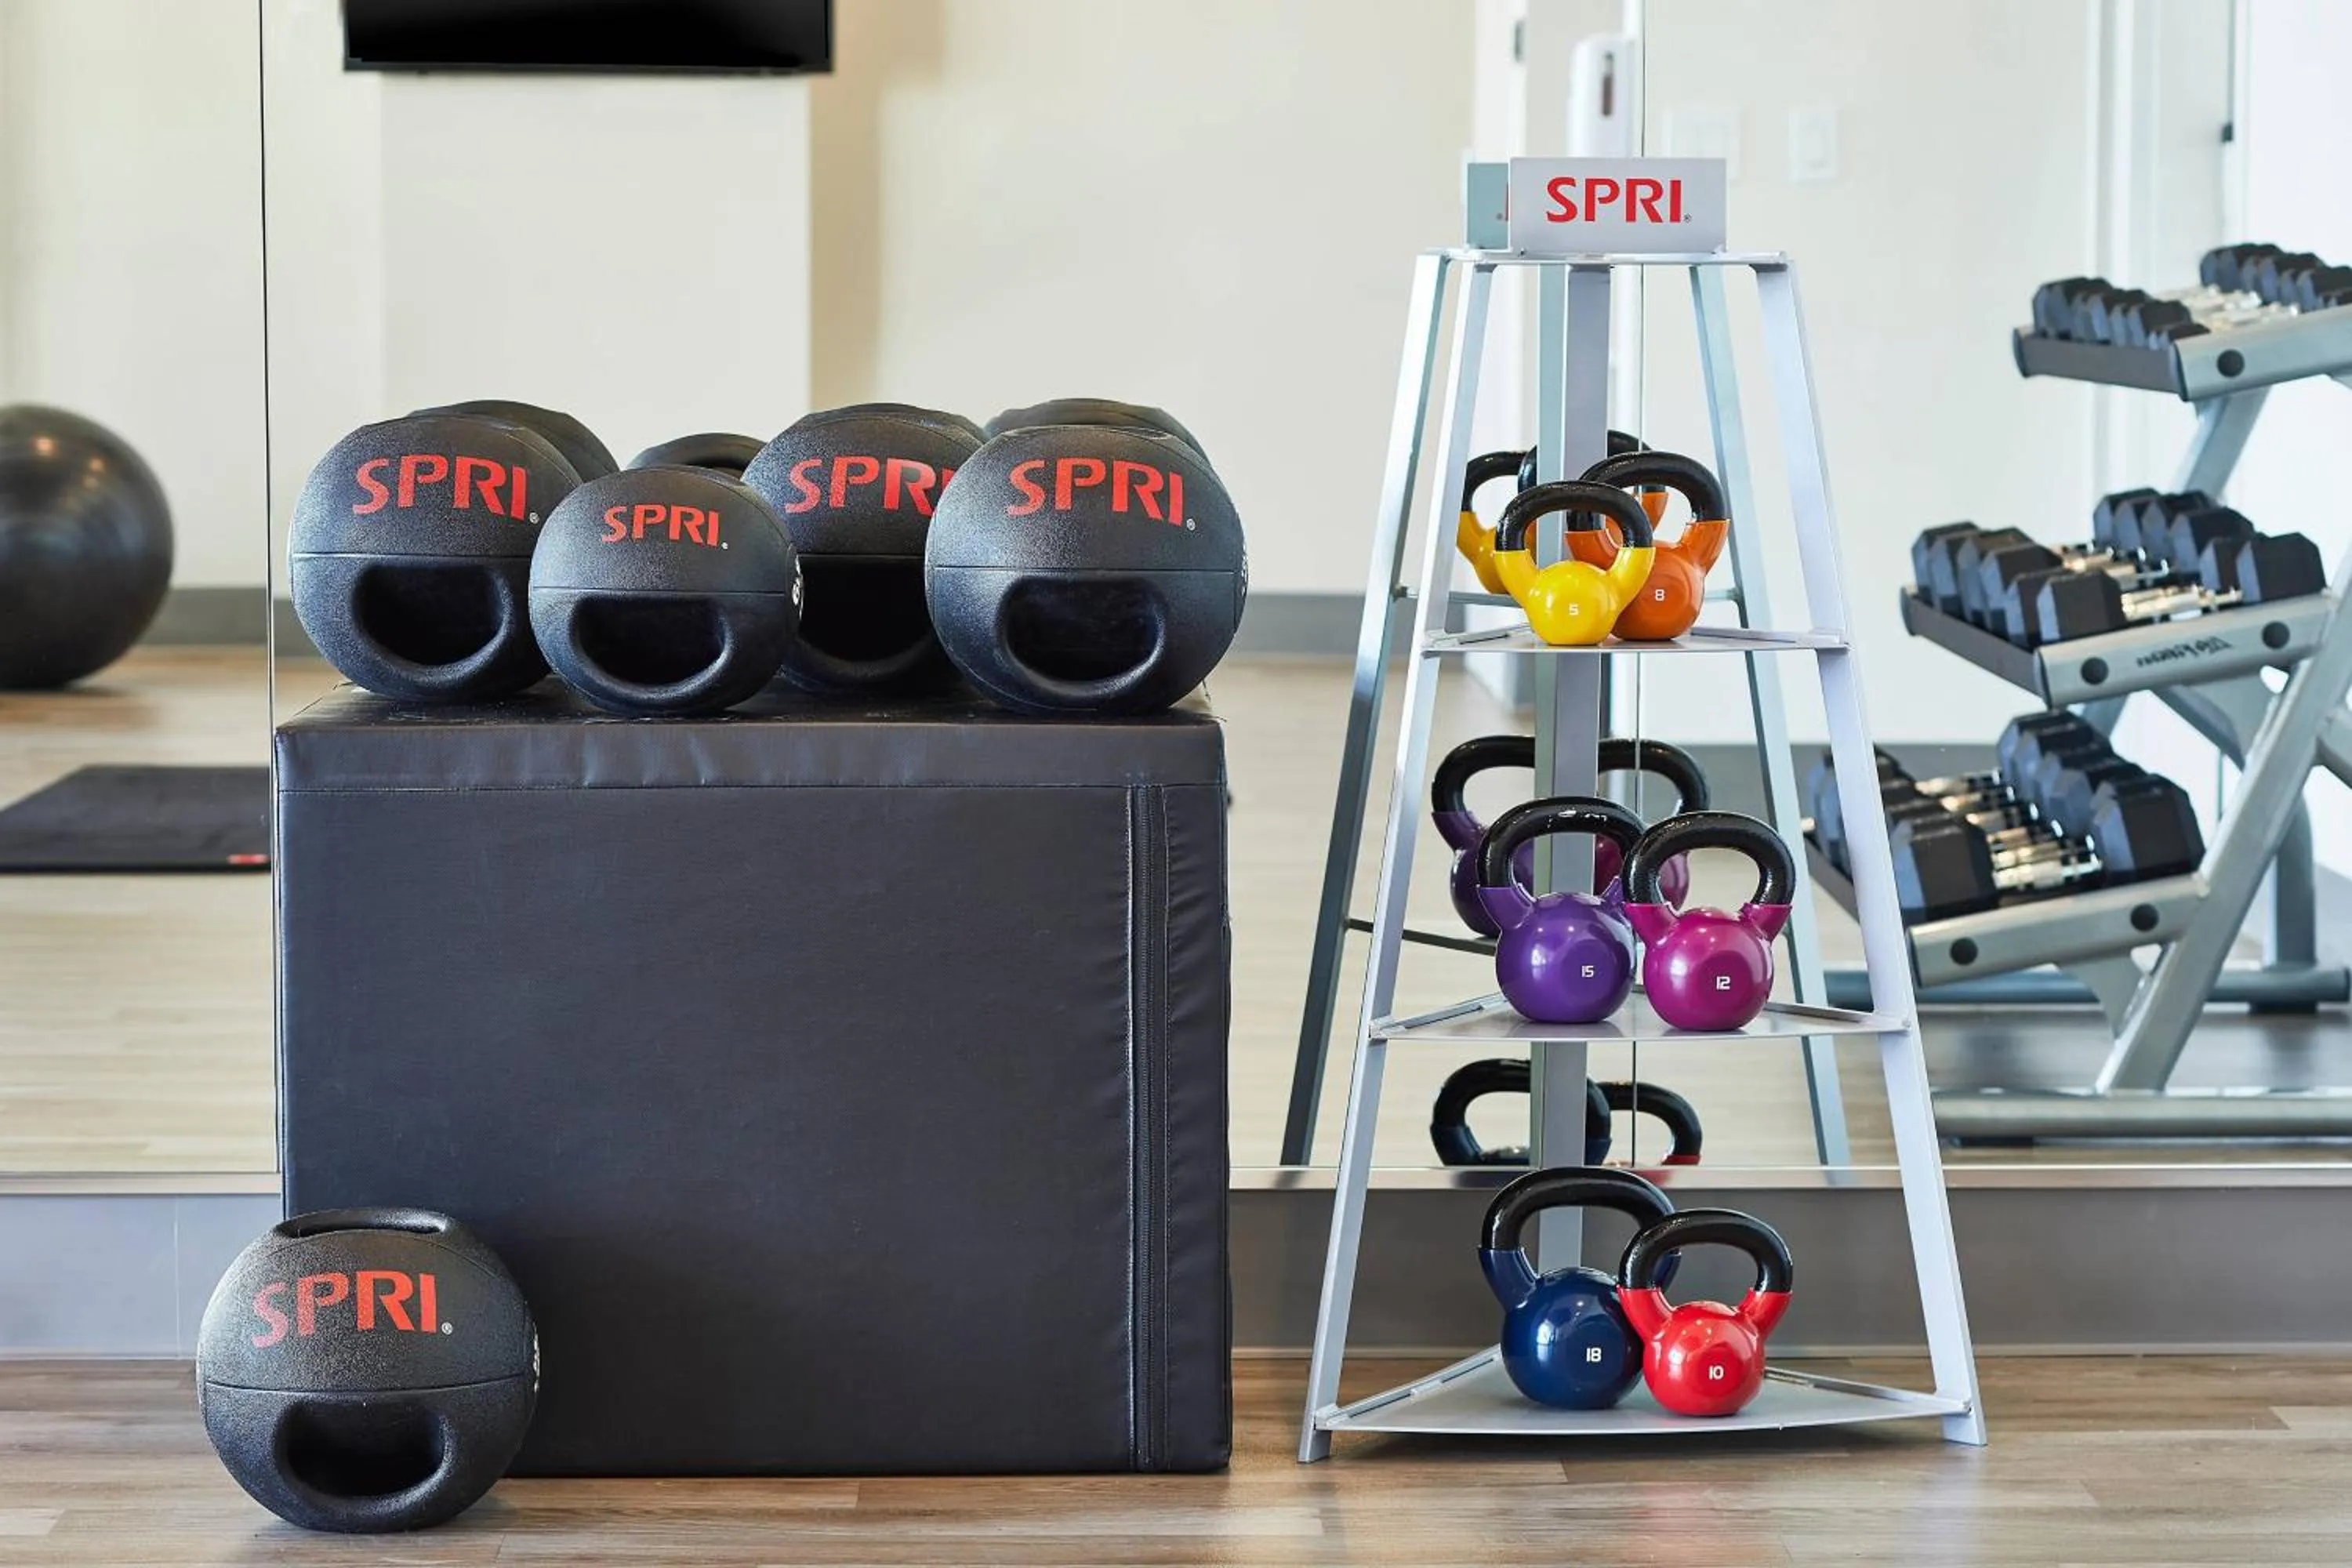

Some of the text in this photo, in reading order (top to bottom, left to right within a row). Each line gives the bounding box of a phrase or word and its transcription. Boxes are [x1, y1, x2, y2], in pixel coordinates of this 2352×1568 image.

[1546, 176, 1682, 223] SPRI
[352, 453, 528, 521] SPRI
[1007, 456, 1184, 527] SPRI
[601, 503, 720, 547] SPRI
[1655, 589, 1665, 601] 8
[1569, 603, 1580, 615] 5
[1581, 965, 1594, 978] 15
[1716, 976, 1731, 990] 12
[252, 1269, 437, 1348] SPRI
[1586, 1347, 1602, 1363] 18
[1708, 1366, 1724, 1380] 10
